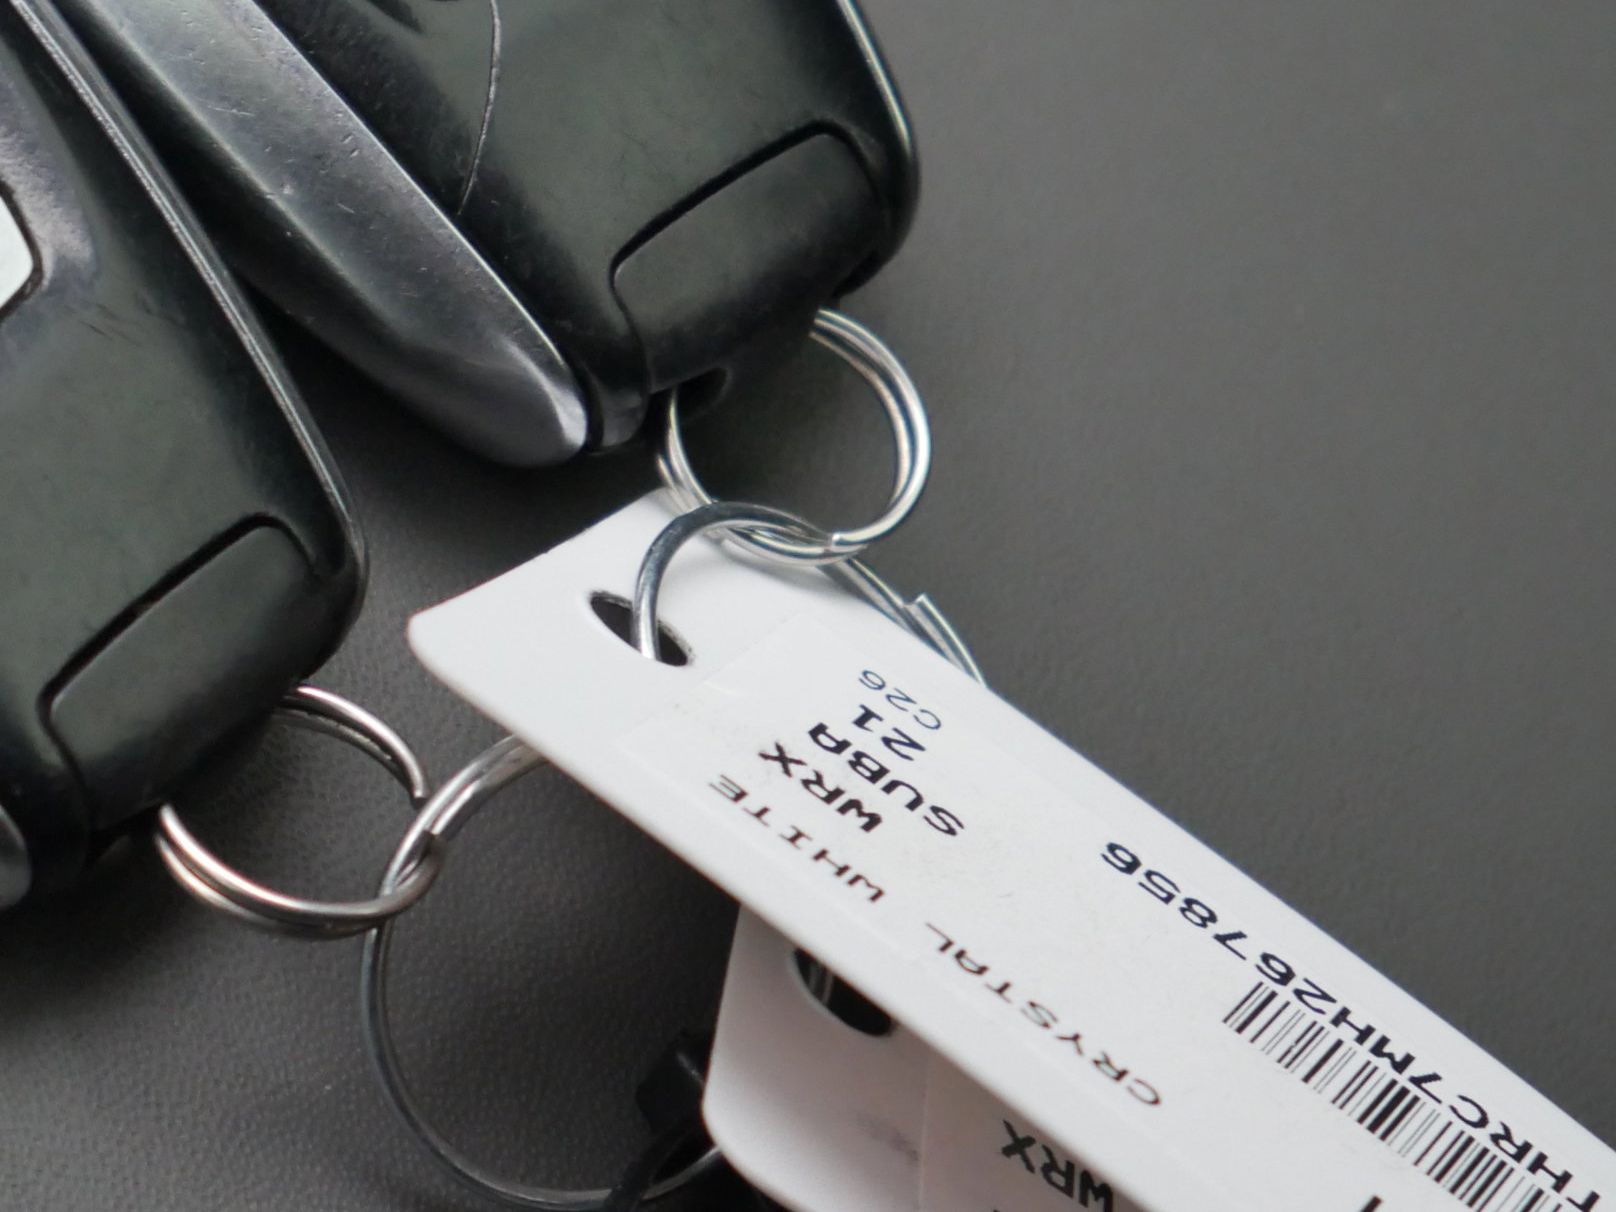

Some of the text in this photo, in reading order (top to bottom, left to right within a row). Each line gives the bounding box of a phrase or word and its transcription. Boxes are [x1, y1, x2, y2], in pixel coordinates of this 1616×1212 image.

[851, 703, 927, 762] 21
[858, 669, 942, 731] C26
[757, 740, 883, 833] WRX
[807, 721, 965, 837] SUBA
[707, 773, 1162, 1107] CRYSTAL WHITE
[1000, 1118, 1114, 1212] WRX
